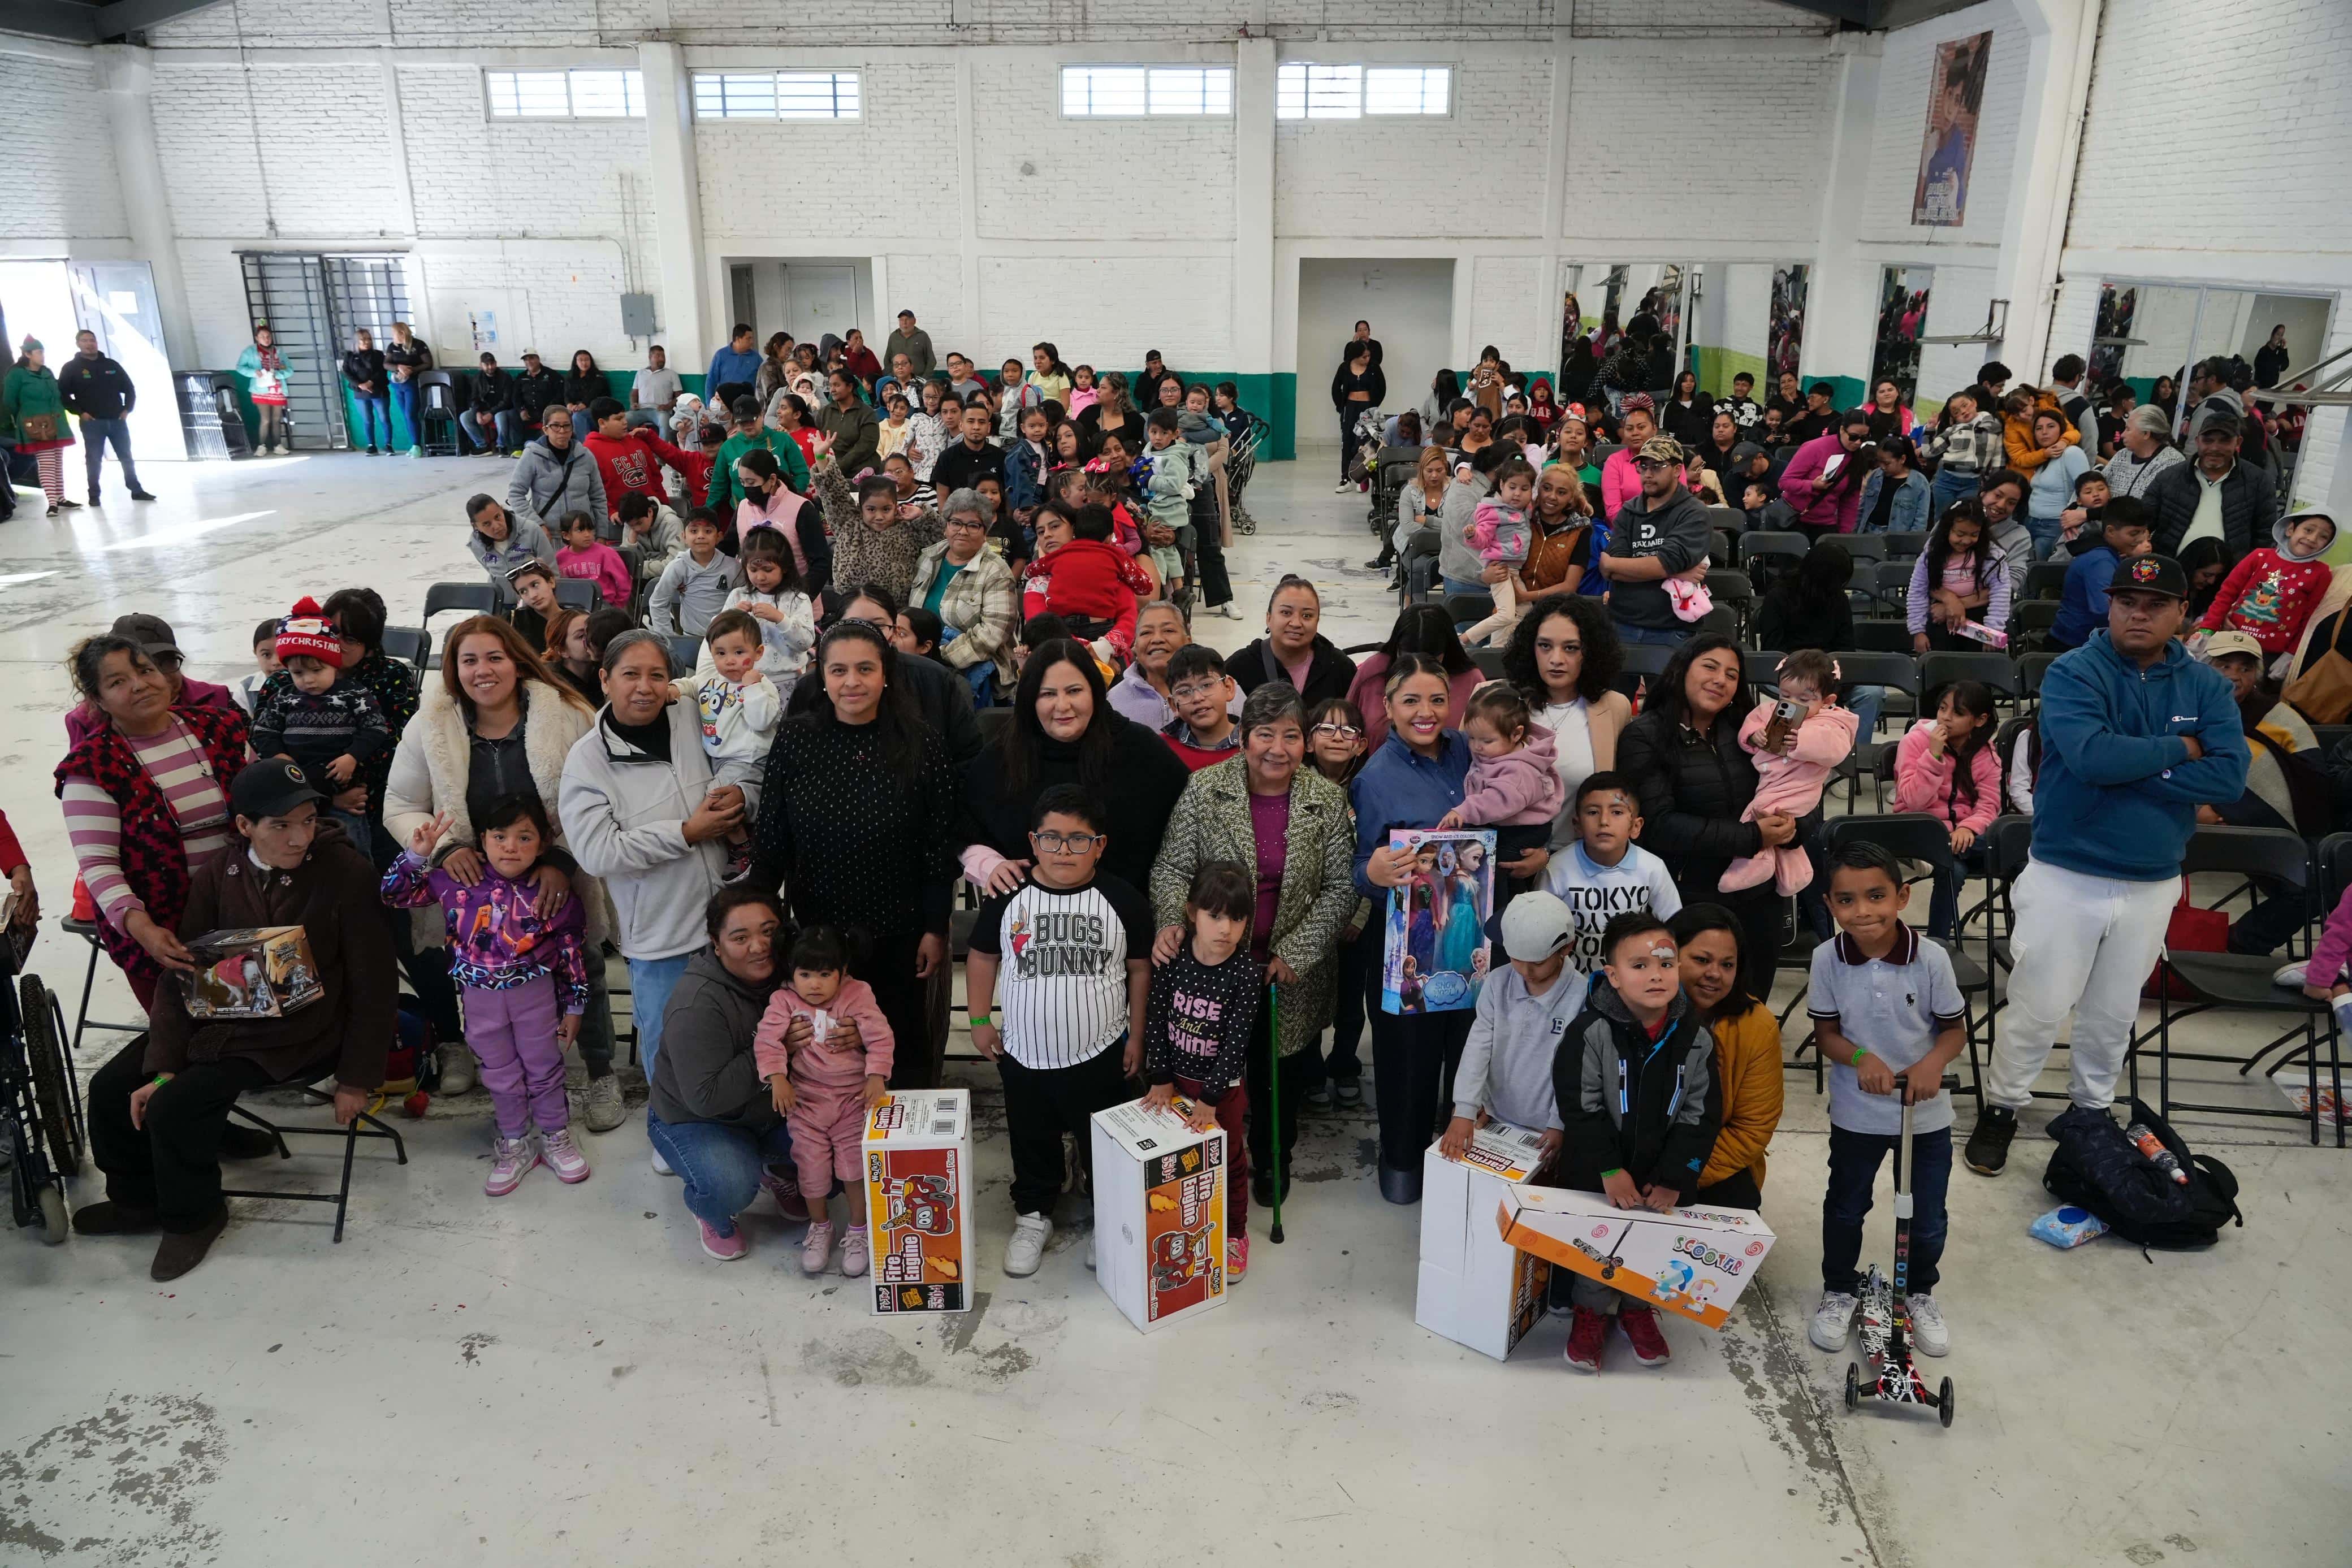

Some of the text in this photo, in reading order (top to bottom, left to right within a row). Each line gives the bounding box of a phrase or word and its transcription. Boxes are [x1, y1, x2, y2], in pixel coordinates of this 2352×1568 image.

[1568, 886, 1650, 910] TOKYO
[1034, 912, 1104, 947] BUGS
[1023, 945, 1114, 980] BUNNY
[1173, 990, 1222, 1021] RISE
[1176, 1017, 1206, 1034] And
[876, 1107, 892, 1129] Carrito
[889, 1105, 904, 1128] Bombero
[871, 1154, 881, 1182] Walking
[1466, 1153, 1507, 1171] Carrito
[1199, 1172, 1213, 1200] Fire
[1182, 1177, 1198, 1225] Engine
[885, 1255, 902, 1282] Fire
[903, 1236, 921, 1281] Engine
[1672, 1235, 1745, 1276] SCOOTER
[1211, 1267, 1221, 1293] Walking
[1893, 1234, 1909, 1327] SCOOTER
